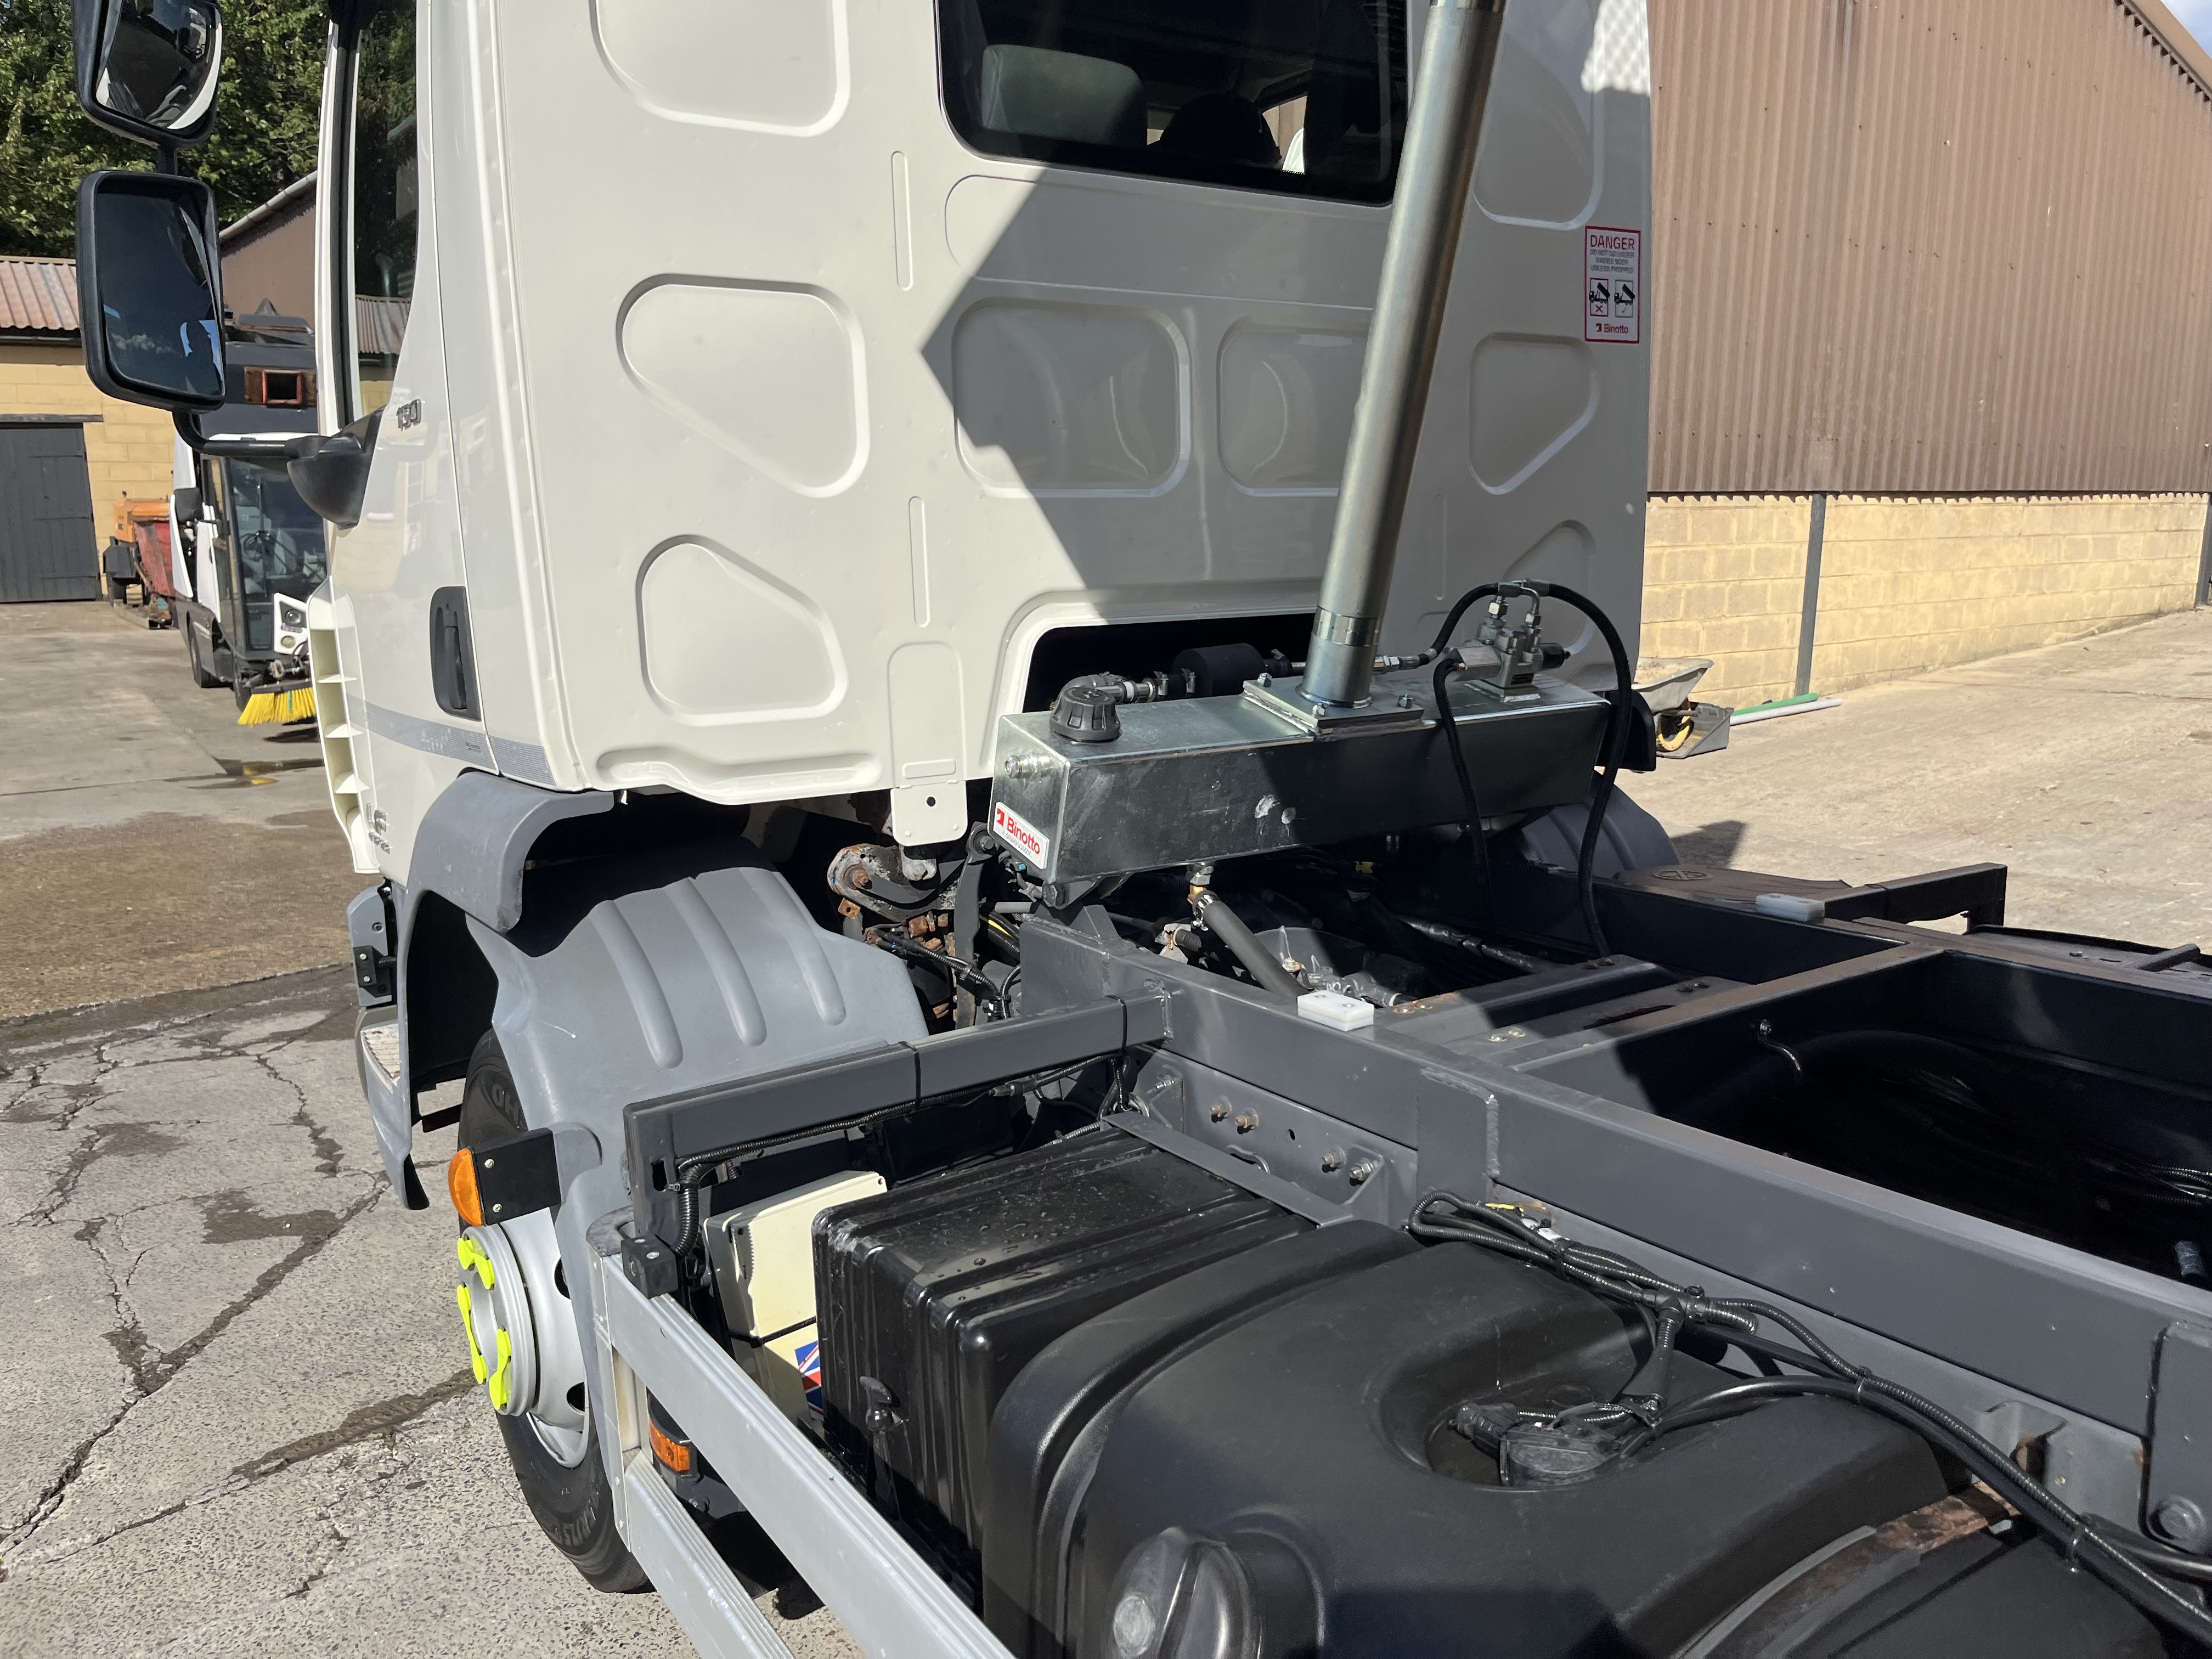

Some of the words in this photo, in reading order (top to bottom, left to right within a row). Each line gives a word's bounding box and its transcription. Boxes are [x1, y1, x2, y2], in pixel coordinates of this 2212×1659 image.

[1590, 235, 1634, 250] DANGER
[1604, 324, 1629, 334] Binotto
[1007, 816, 1040, 854] Binotto
